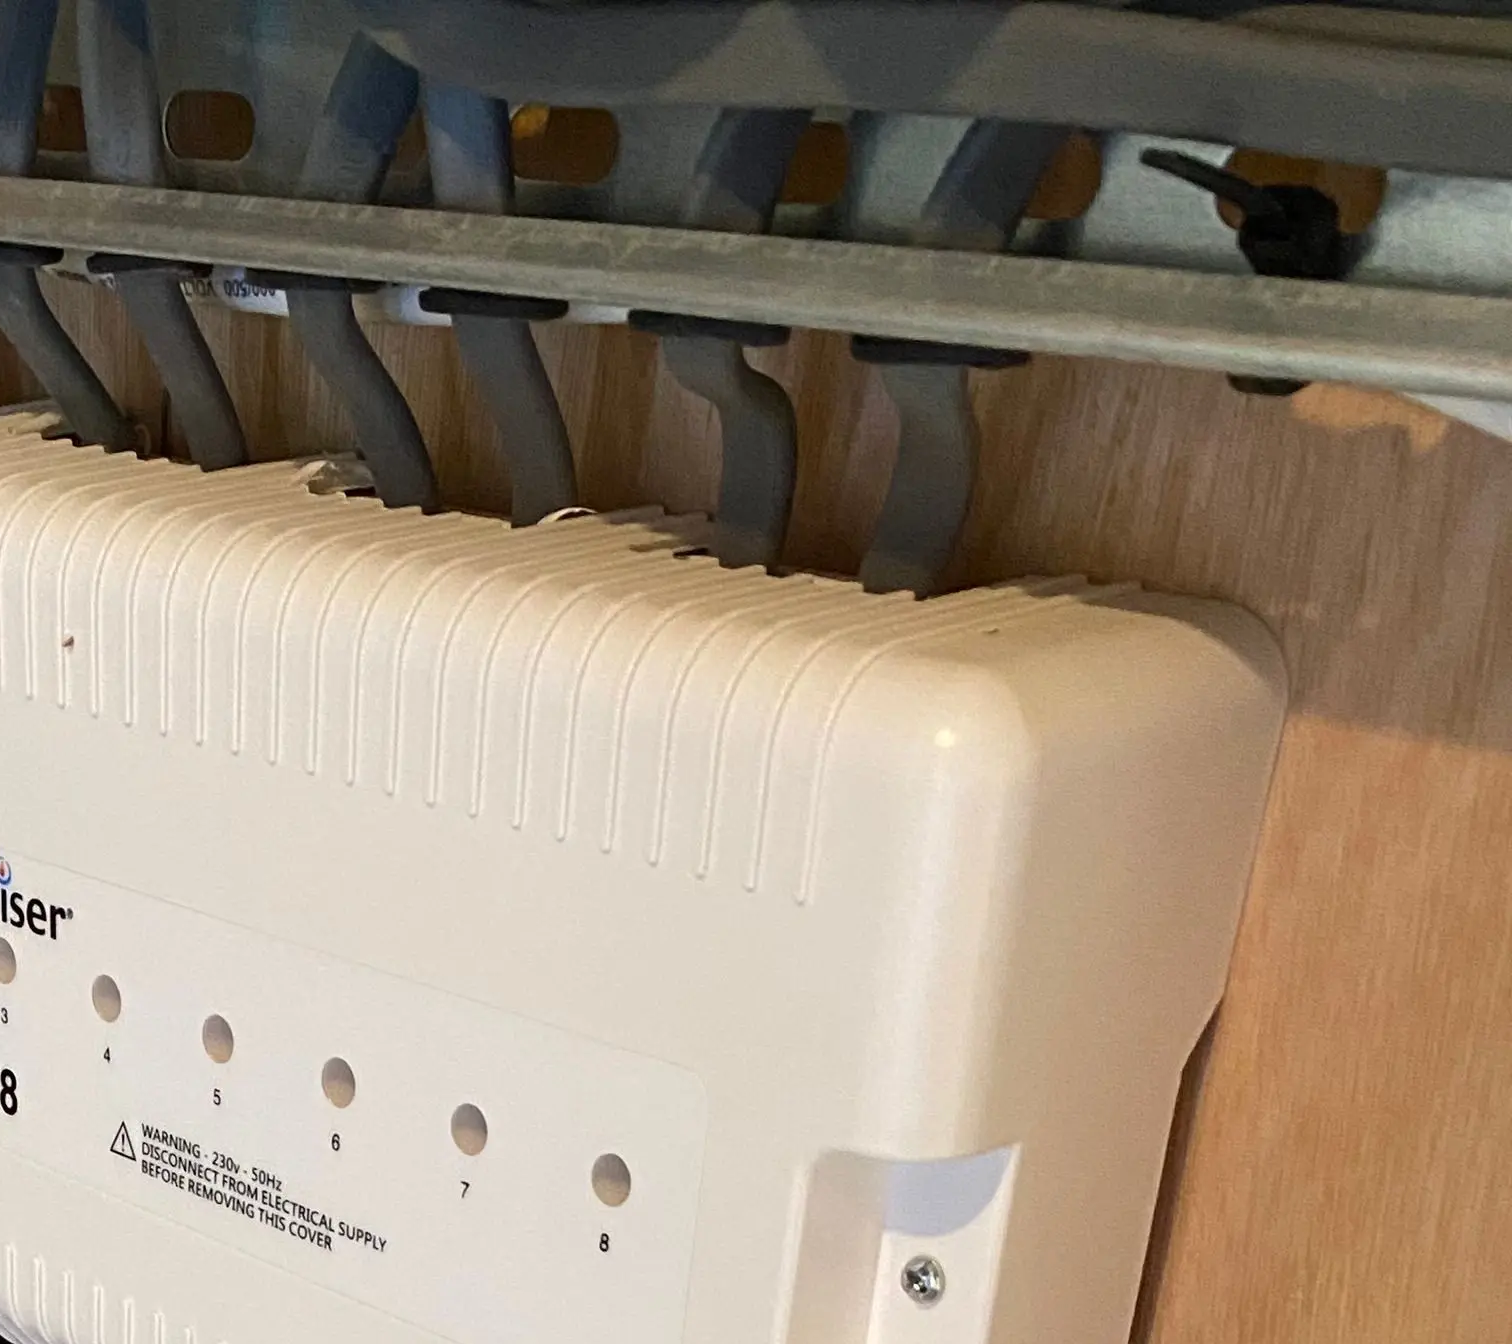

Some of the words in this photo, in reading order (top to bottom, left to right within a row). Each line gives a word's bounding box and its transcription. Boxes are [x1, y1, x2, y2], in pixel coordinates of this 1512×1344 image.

[0, 1005, 9, 1024] 3
[102, 1045, 111, 1065] 4
[212, 1088, 222, 1107] 5
[330, 1133, 341, 1152] 6
[459, 1180, 471, 1200] 7
[598, 1232, 610, 1253] 8
[141, 1123, 201, 1159] WARNING
[212, 1151, 240, 1175] 230v
[251, 1167, 282, 1192] 50Hz
[141, 1141, 219, 1185] DISCONNECT
[222, 1174, 258, 1201] FROM
[262, 1190, 335, 1233] ELECTRICAL
[338, 1221, 387, 1253] SUPPLY
[141, 1159, 185, 1190] BEFORE
[188, 1179, 255, 1220] REMOVING
[258, 1207, 286, 1232] THIS
[288, 1221, 333, 1251] COVER
